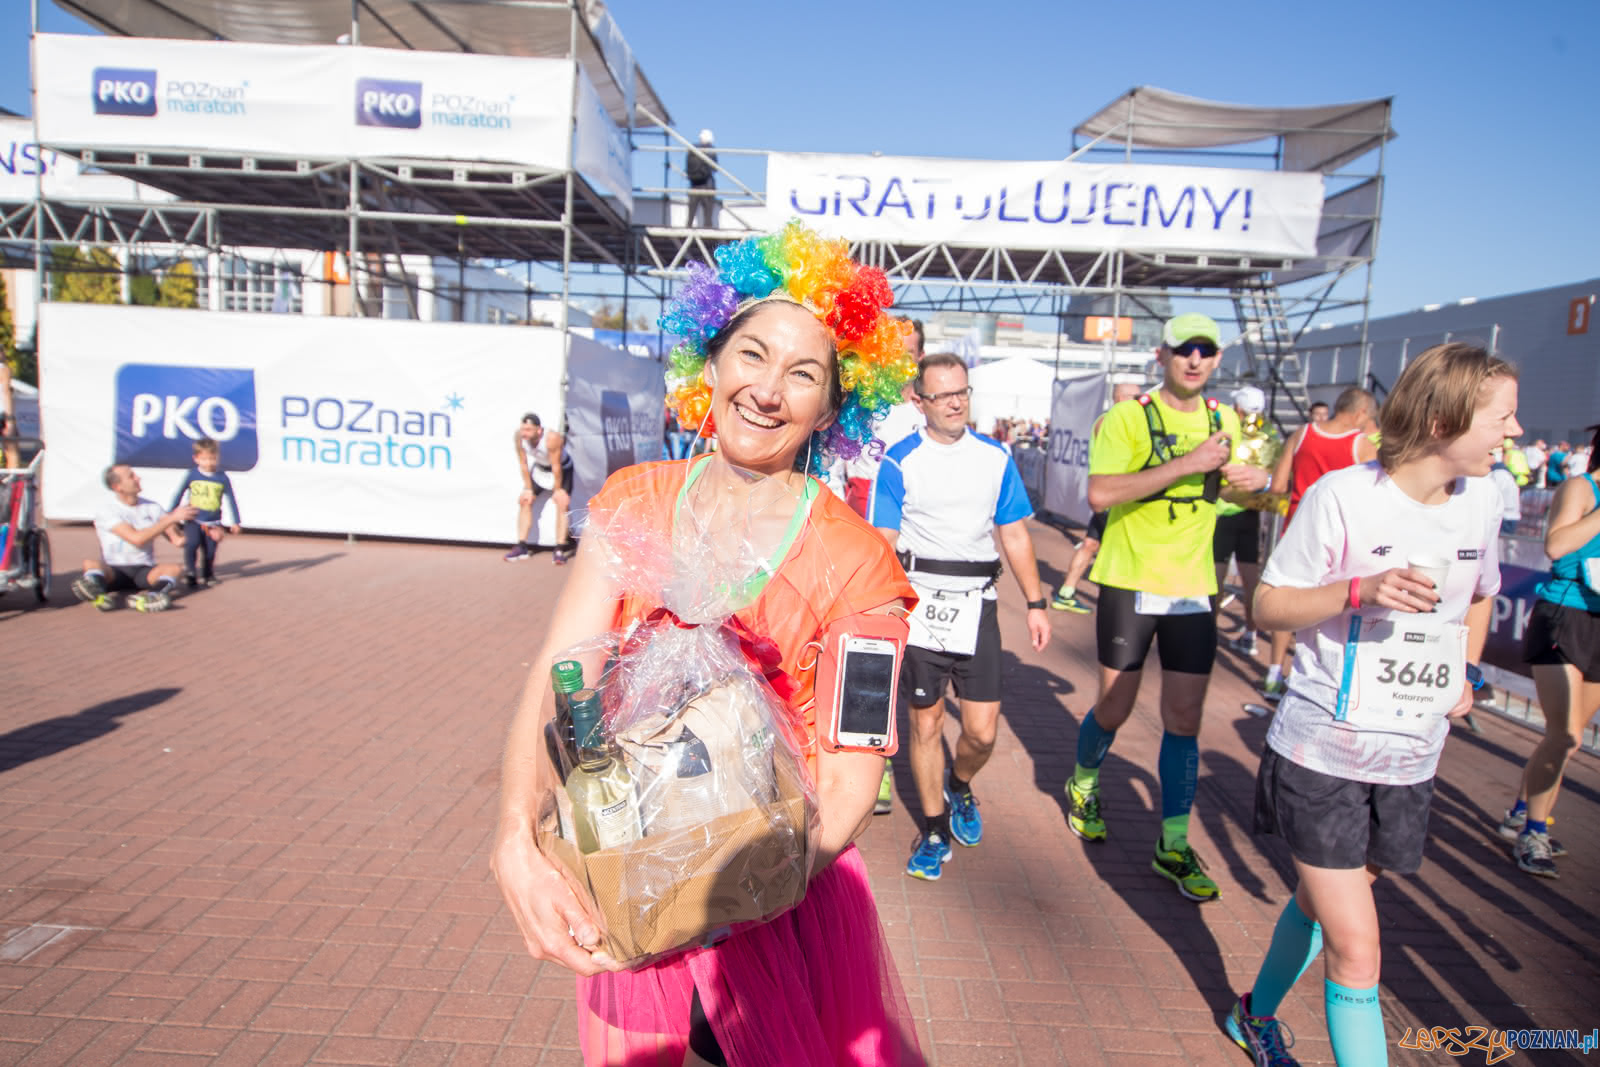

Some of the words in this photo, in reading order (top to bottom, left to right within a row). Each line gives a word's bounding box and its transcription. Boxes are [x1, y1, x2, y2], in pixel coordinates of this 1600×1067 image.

[99, 80, 150, 104] PKO
[364, 91, 415, 117] PKO
[167, 98, 246, 114] maraton
[432, 111, 511, 129] maraton
[790, 173, 1252, 232] GRATULUJEMY!
[131, 393, 240, 441] PKO
[281, 434, 452, 470] maraton
[1371, 546, 1393, 556] 4F
[925, 604, 960, 624] 867
[1376, 657, 1450, 689] 3648
[1392, 691, 1435, 703] Katarzyna
